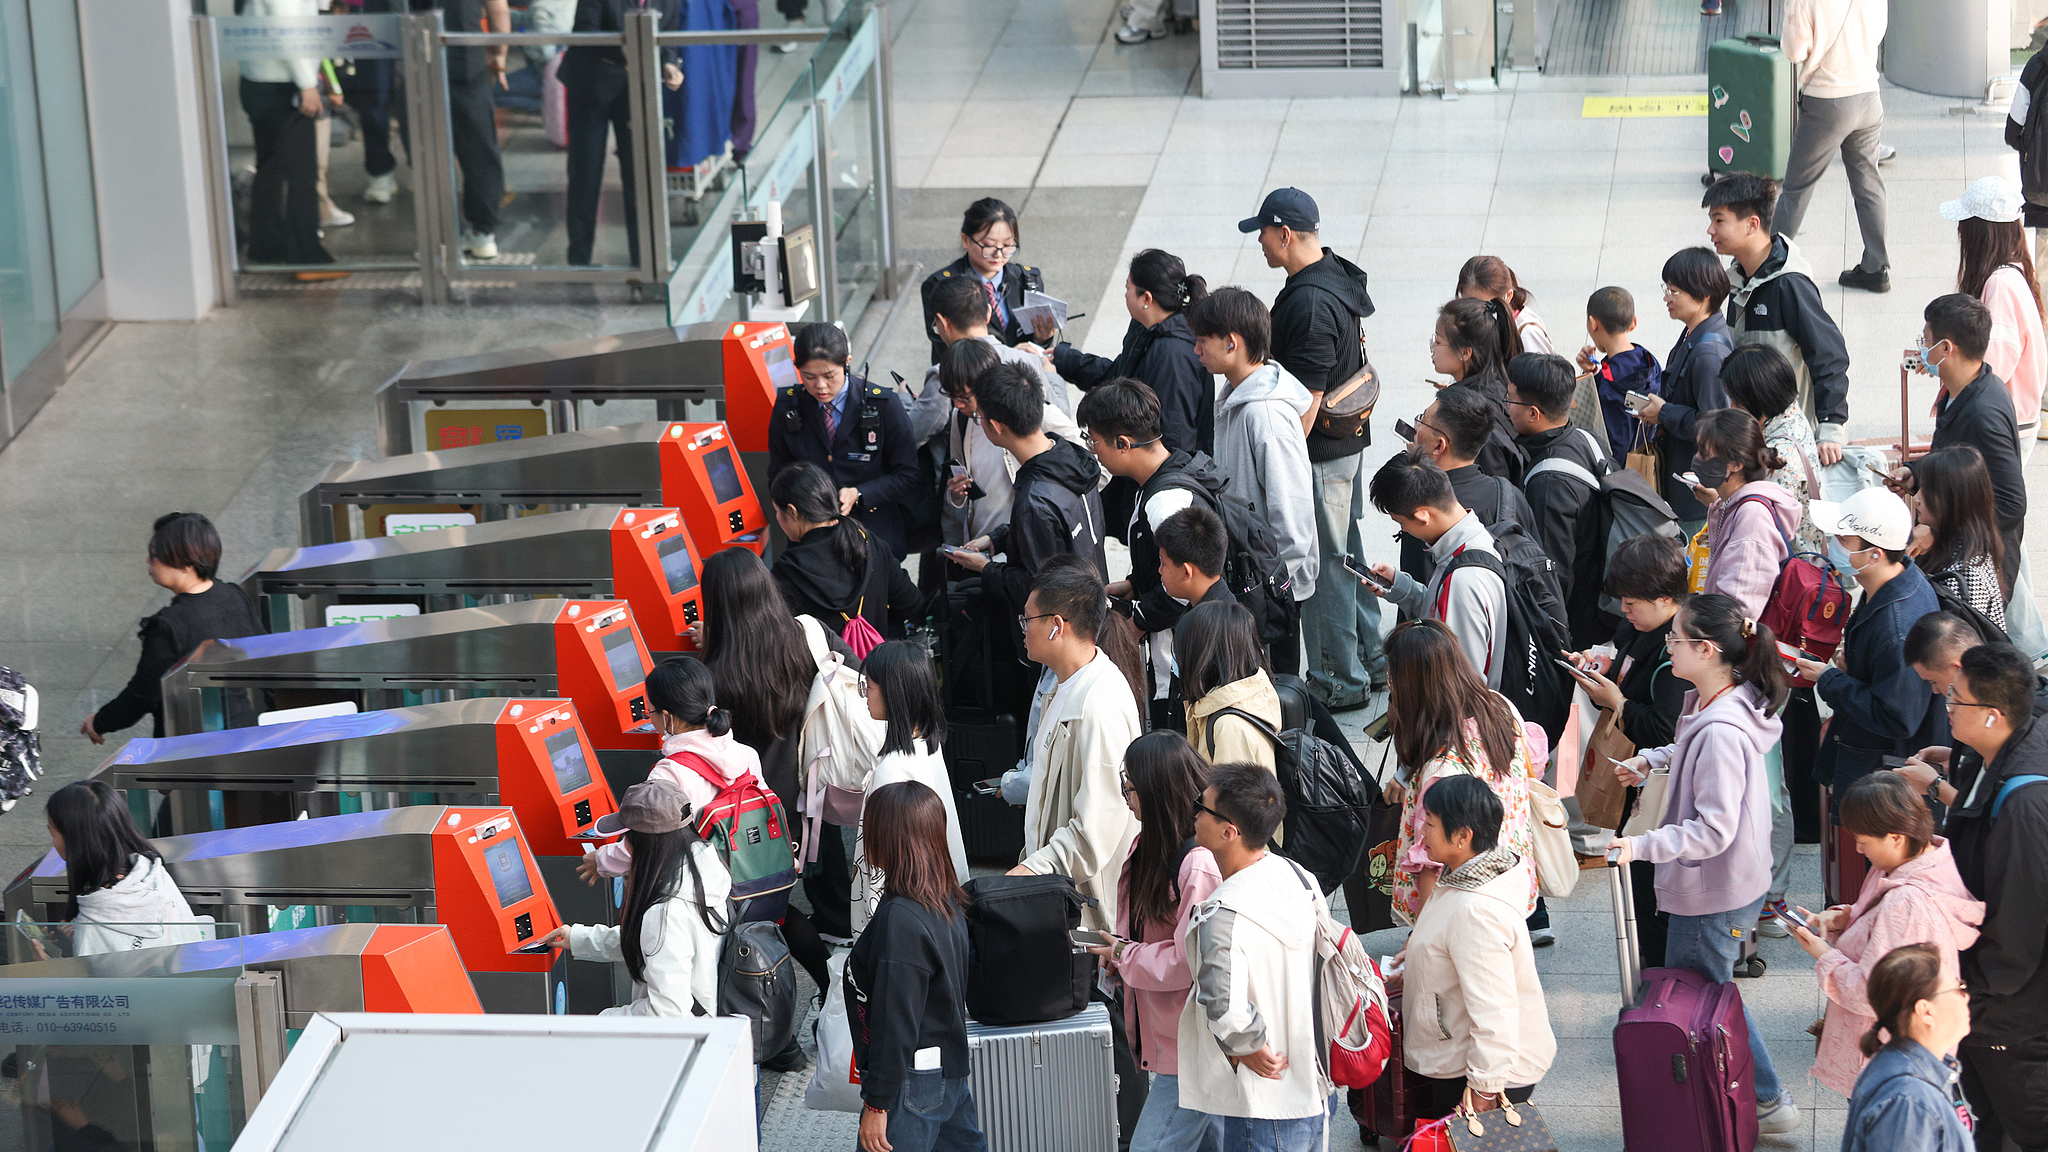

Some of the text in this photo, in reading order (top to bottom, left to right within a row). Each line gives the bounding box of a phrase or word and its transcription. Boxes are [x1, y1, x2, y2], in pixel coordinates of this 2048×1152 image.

[1837, 513, 1882, 537] Cloud.
[0, 995, 130, 1009] 纪传媒广告有限公司
